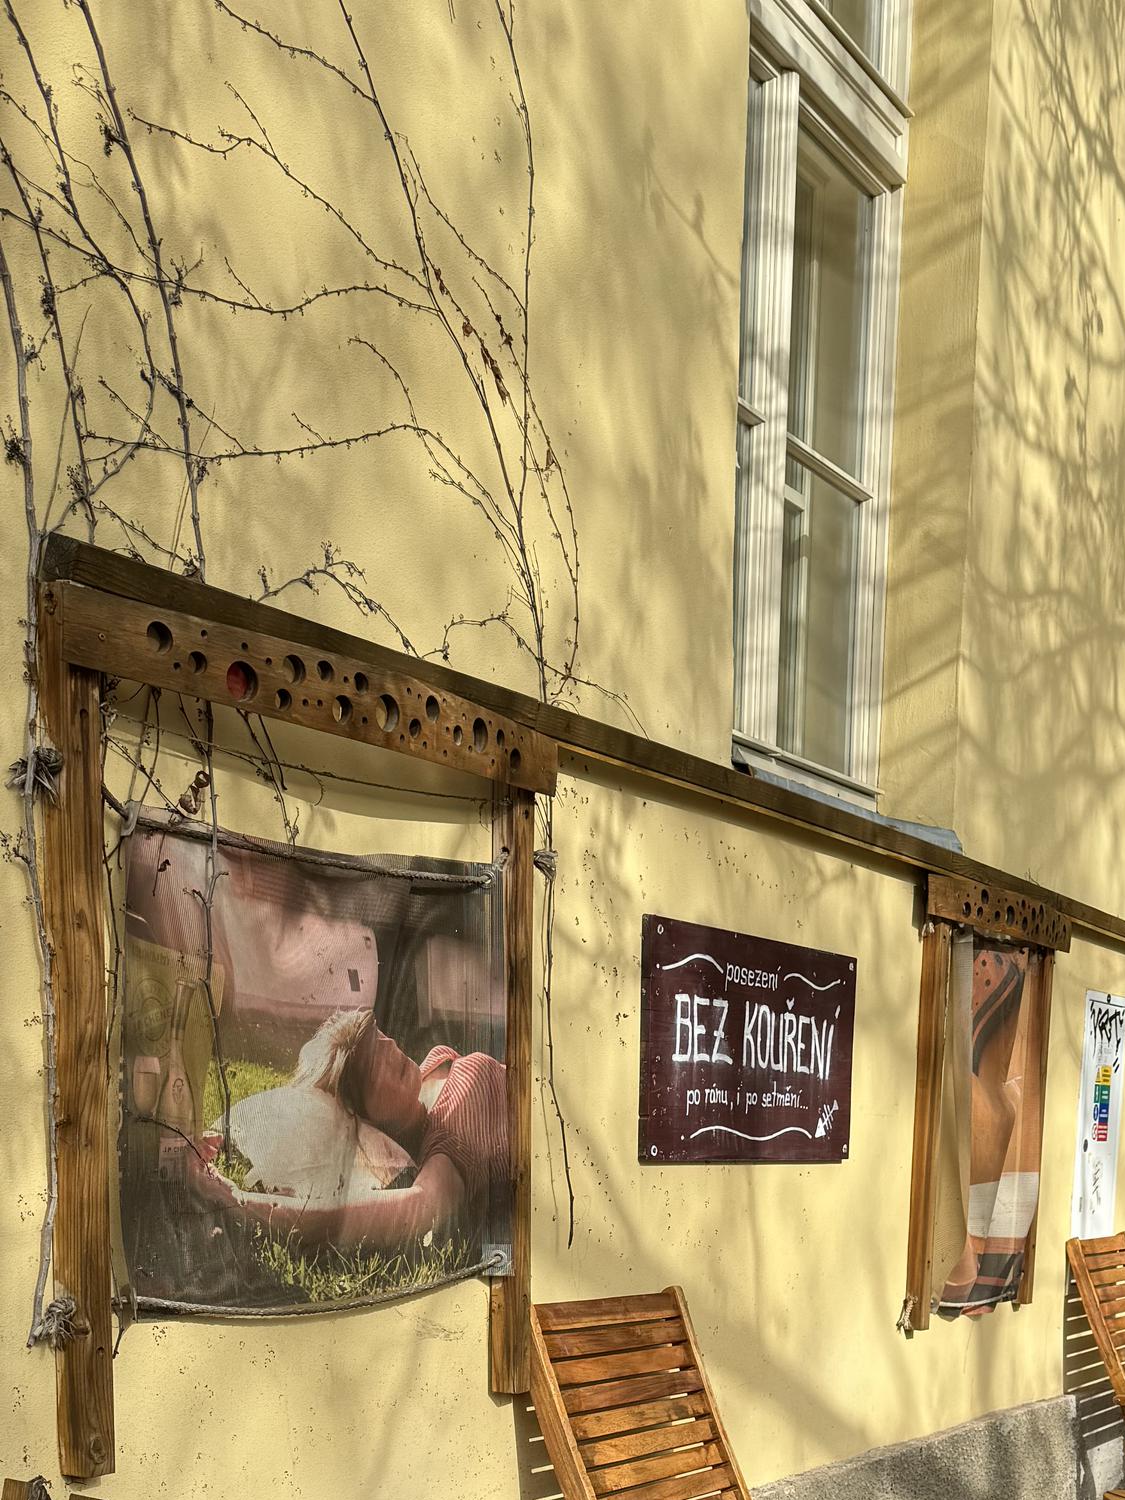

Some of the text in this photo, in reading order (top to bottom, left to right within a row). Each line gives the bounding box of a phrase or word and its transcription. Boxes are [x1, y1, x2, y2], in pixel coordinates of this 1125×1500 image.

[725, 962, 782, 992] posezení
[672, 993, 841, 1081] BEZ KOUŘENÍ
[686, 1088, 701, 1116] po
[736, 1086, 741, 1106] i
[745, 1091, 758, 1115] po
